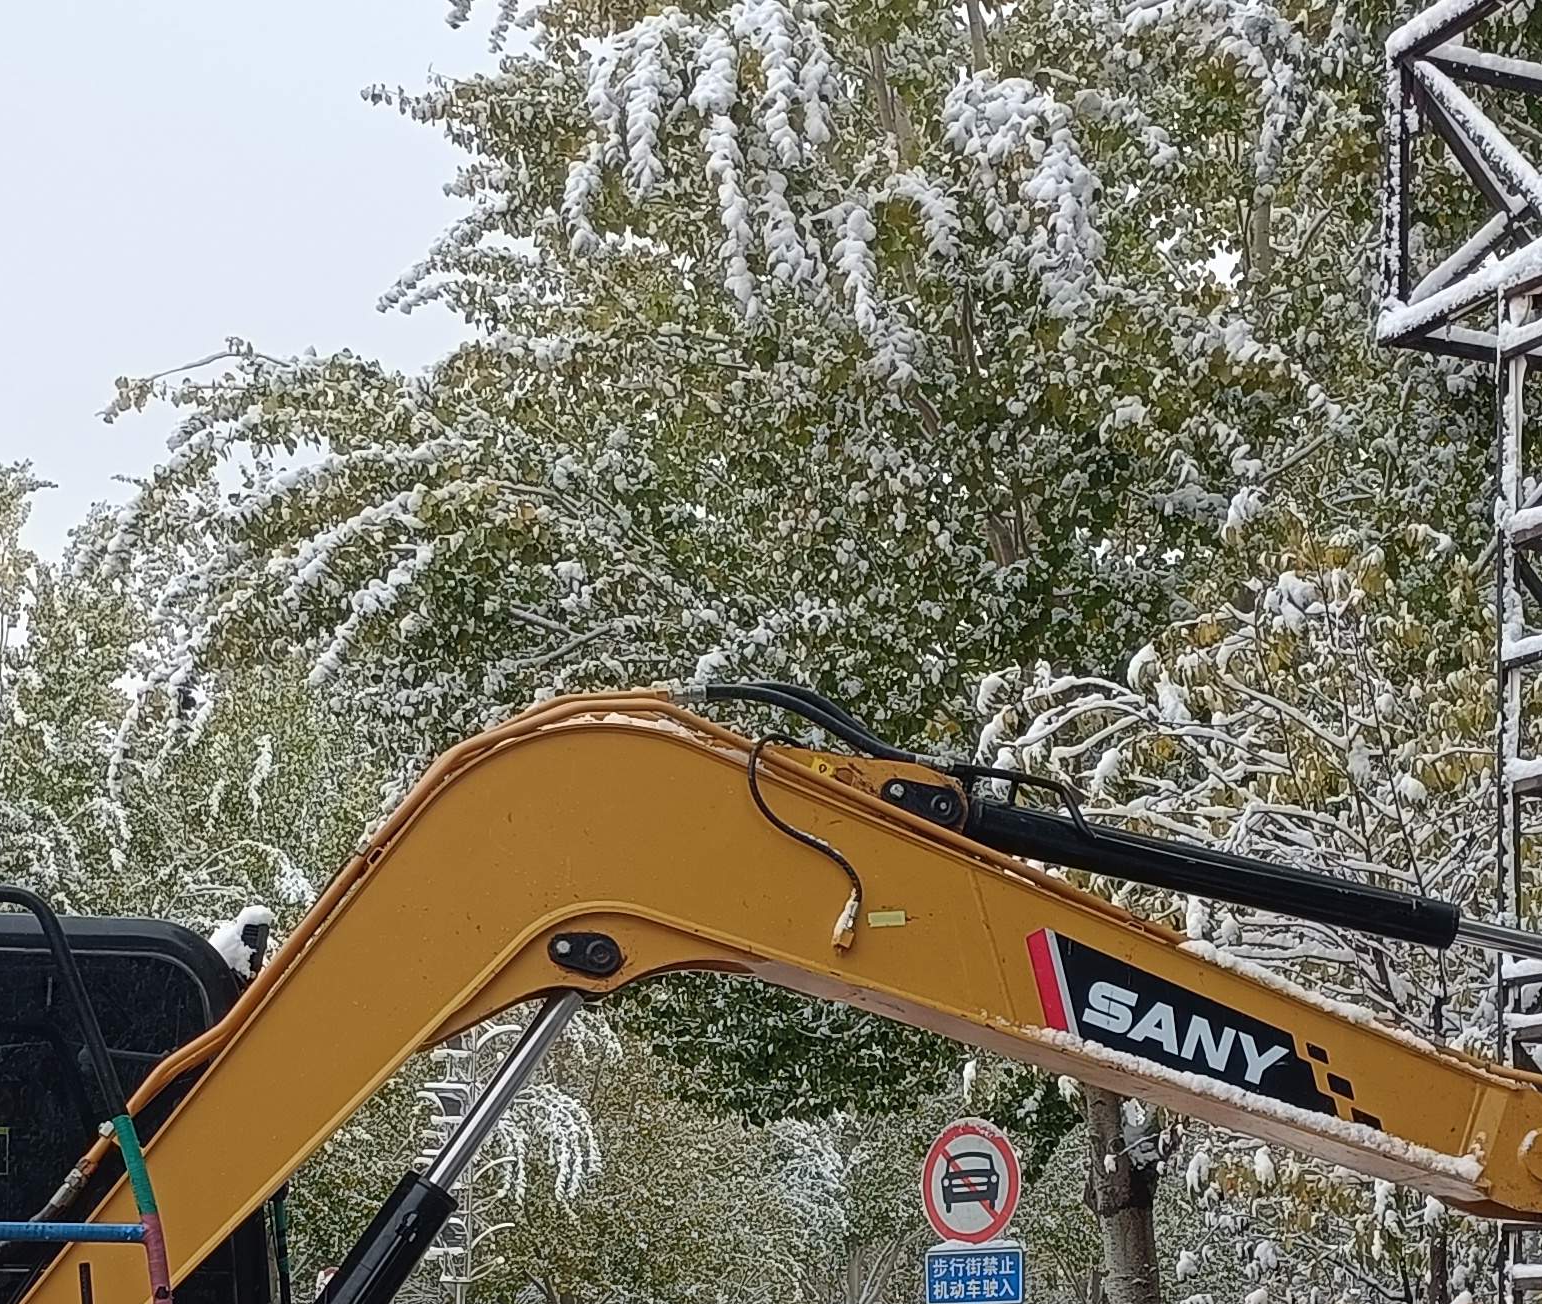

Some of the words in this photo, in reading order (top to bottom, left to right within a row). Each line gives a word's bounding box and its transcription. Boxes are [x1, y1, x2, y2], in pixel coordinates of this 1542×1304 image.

[1081, 980, 1290, 1085] SANY
[932, 1255, 1016, 1279] 步行街禁止
[932, 1278, 1015, 1300] 机动车驶入
